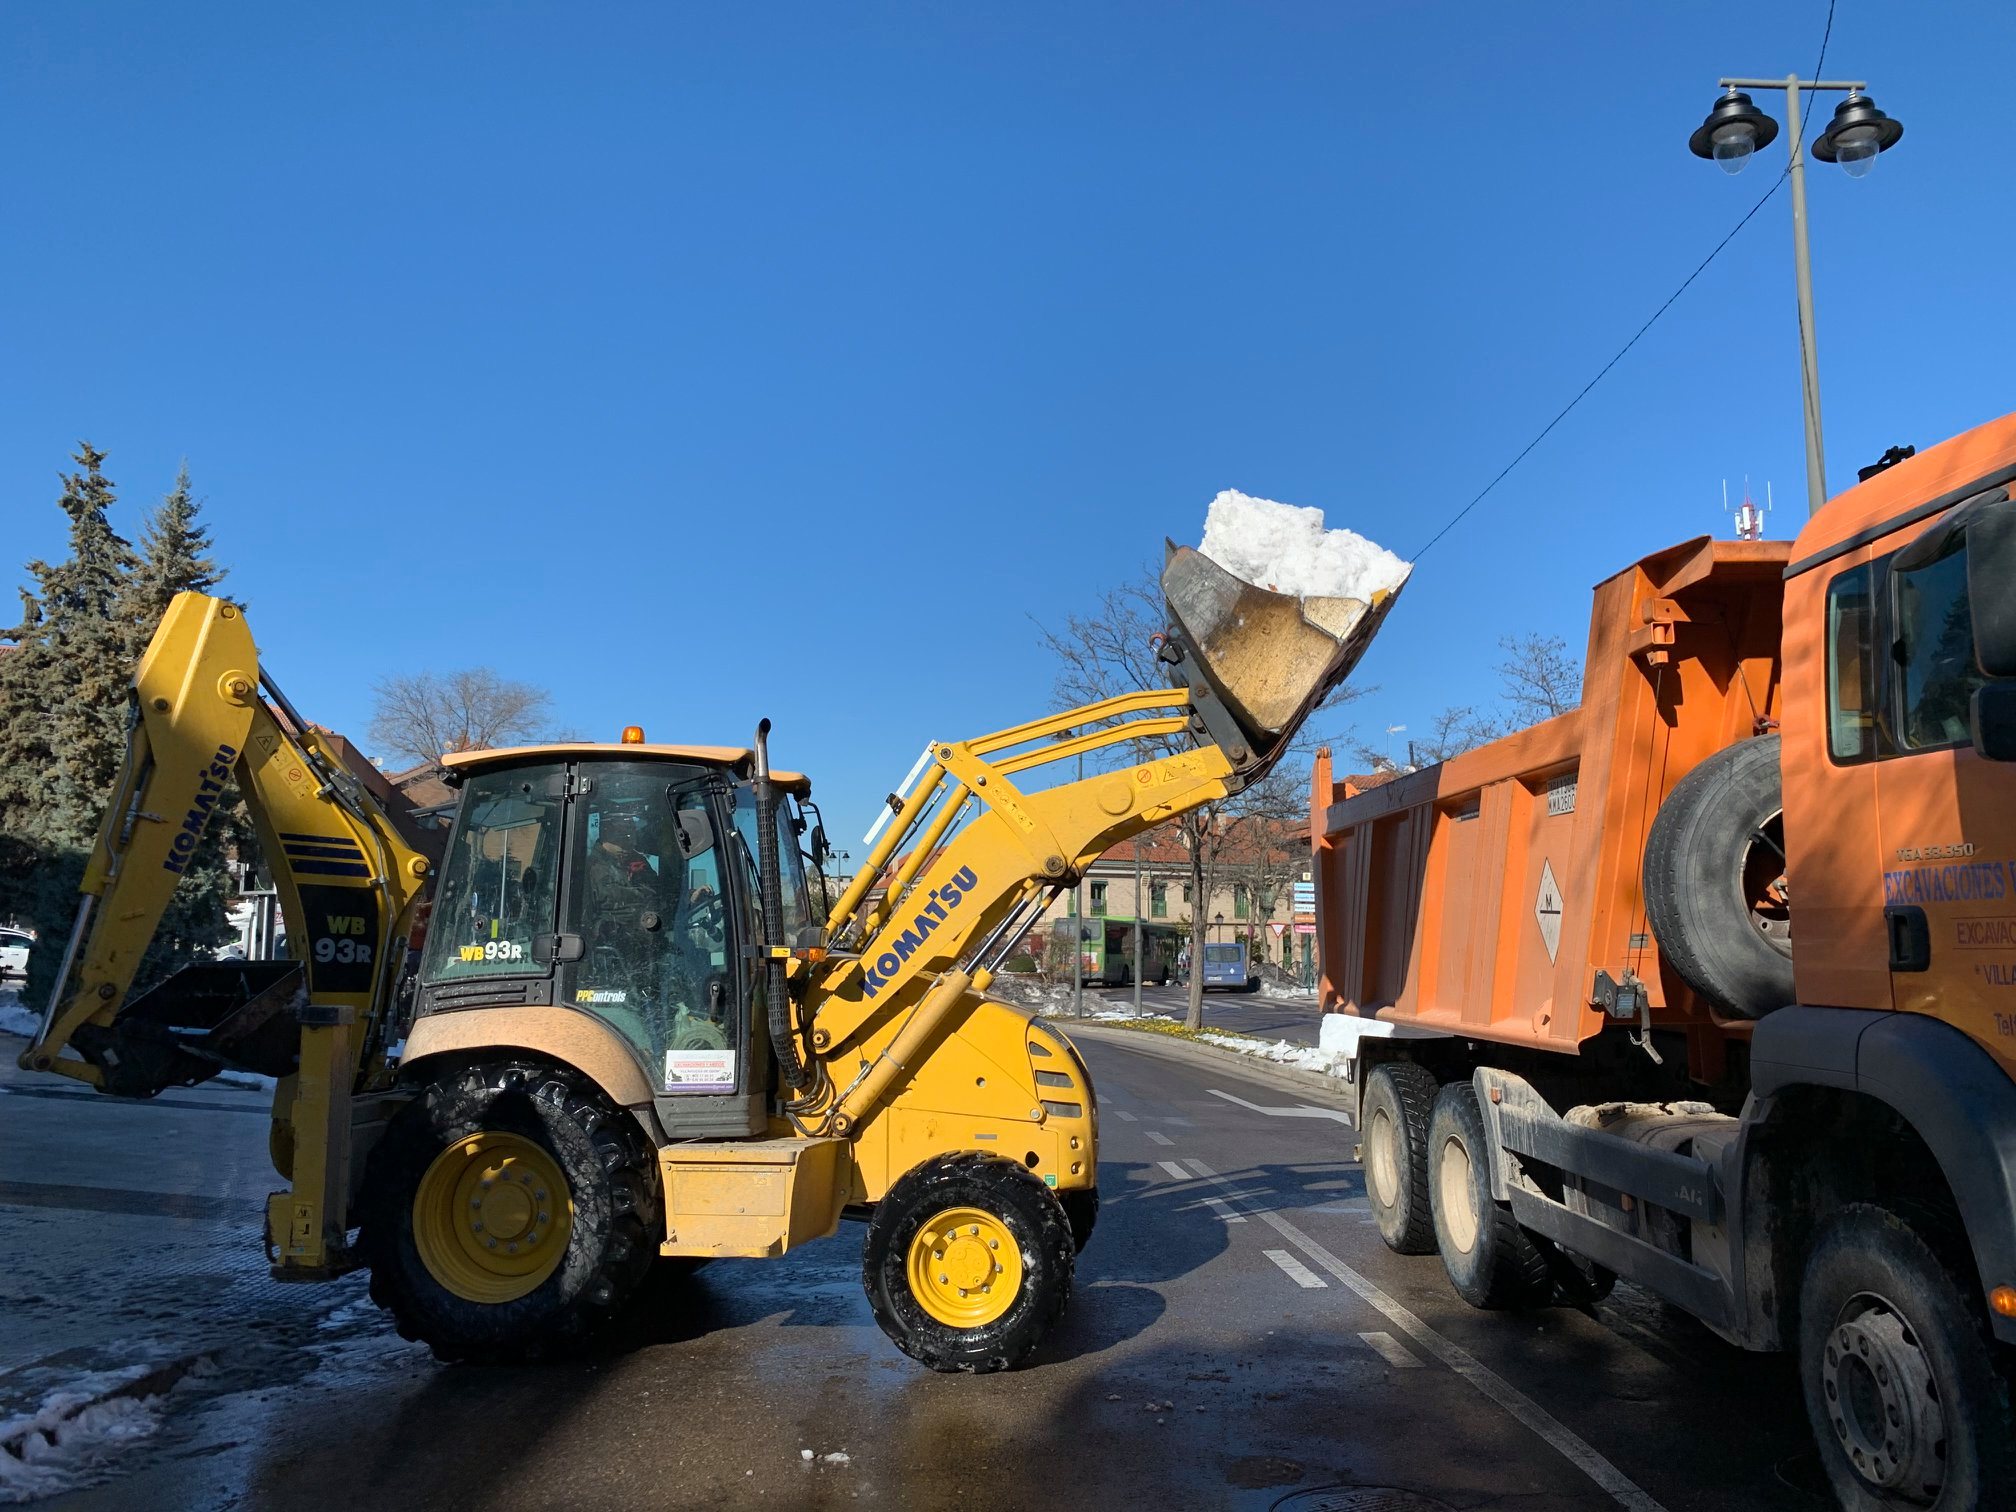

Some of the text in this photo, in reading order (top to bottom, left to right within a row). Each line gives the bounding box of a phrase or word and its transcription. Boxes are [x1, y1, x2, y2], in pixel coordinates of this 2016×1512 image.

[163, 744, 237, 874] KOMATSU
[1884, 861, 2006, 907] EXCAVACIONES
[326, 915, 366, 935] WB
[863, 864, 979, 999] KOMATSU
[314, 937, 372, 964] 93R
[1993, 1012, 2016, 1036] Tel
